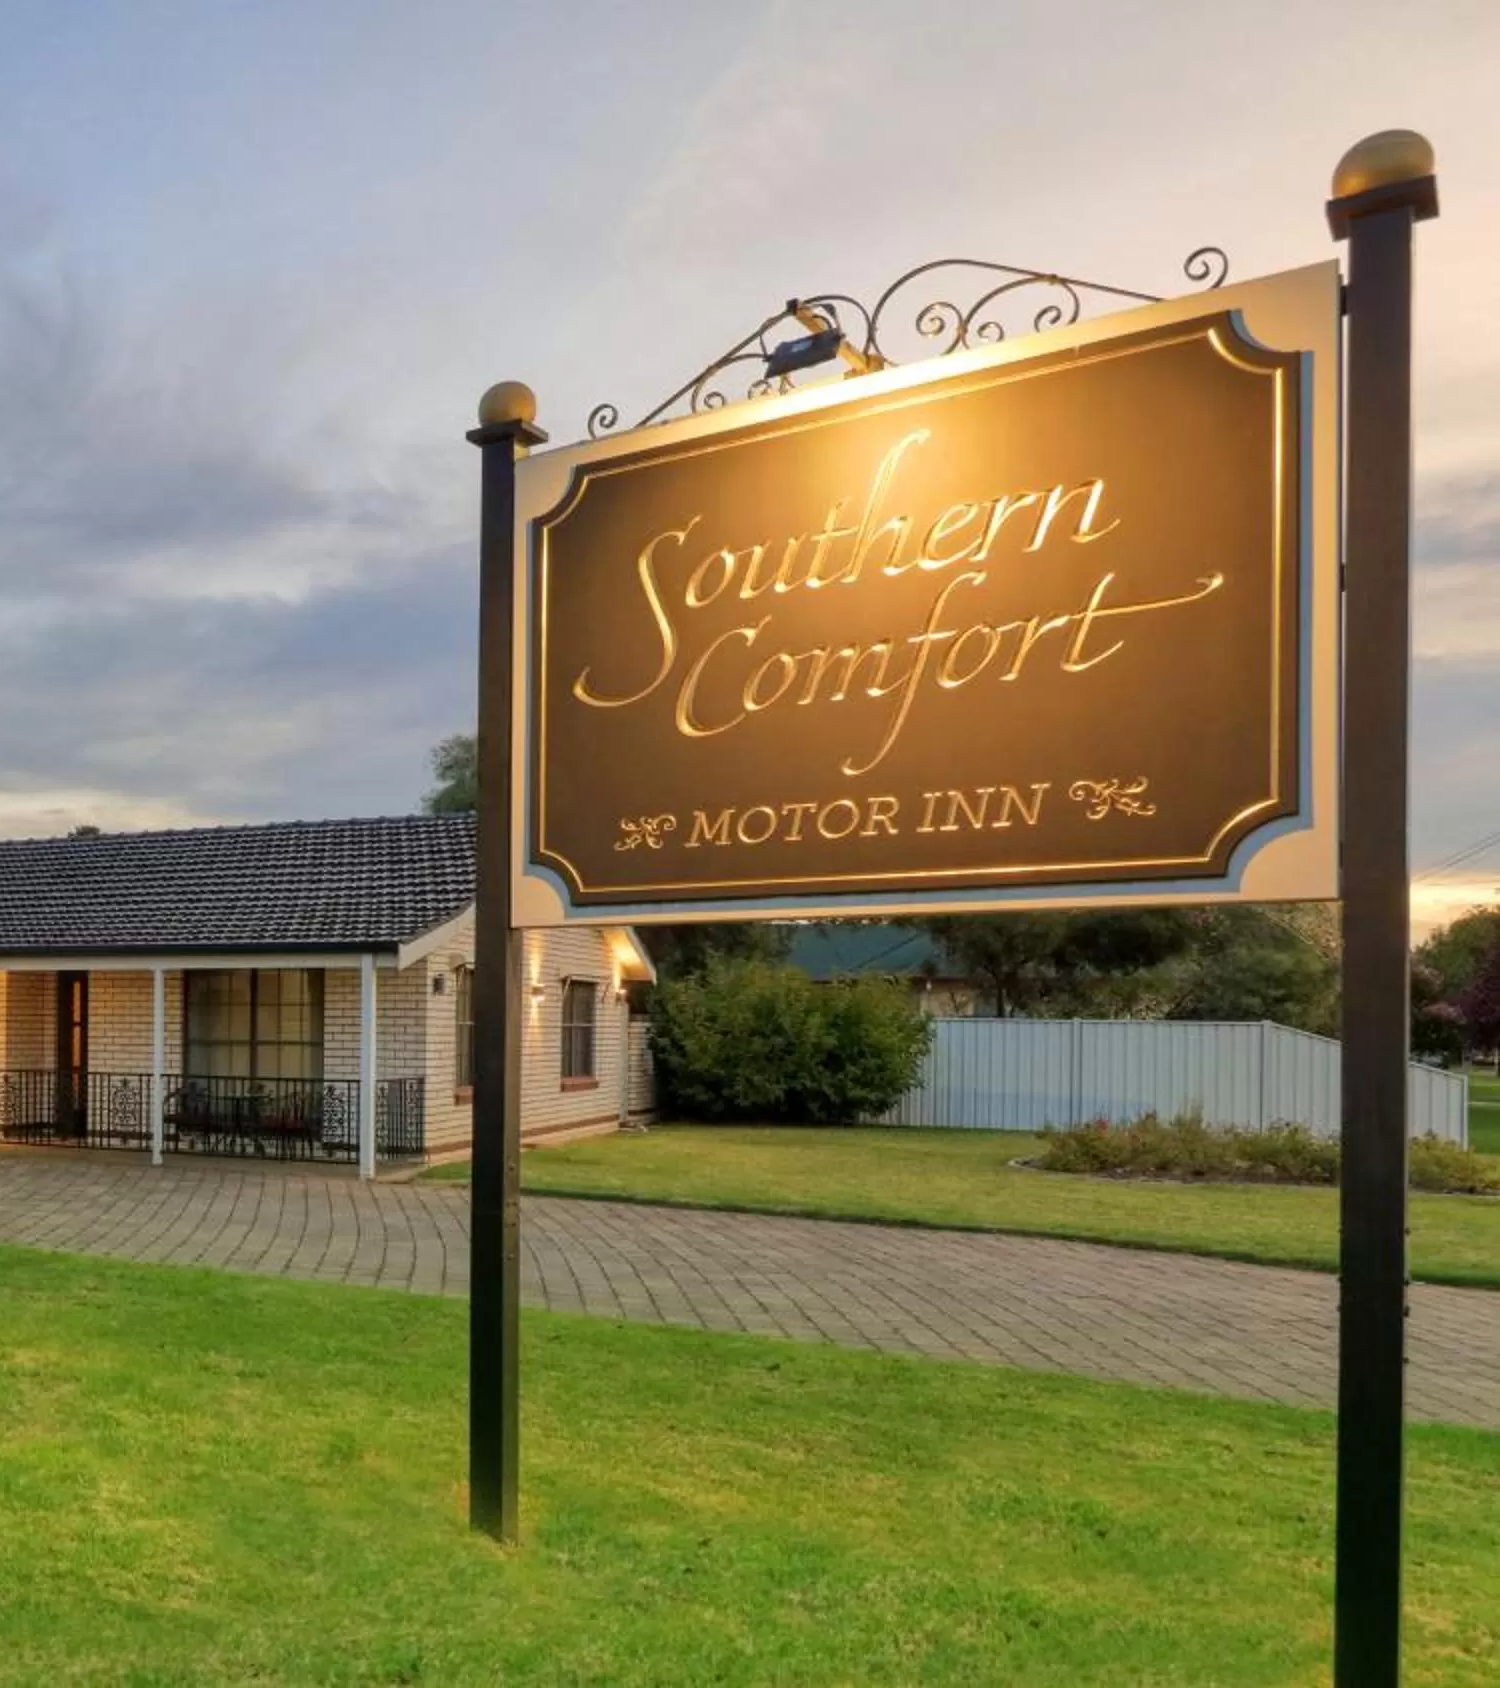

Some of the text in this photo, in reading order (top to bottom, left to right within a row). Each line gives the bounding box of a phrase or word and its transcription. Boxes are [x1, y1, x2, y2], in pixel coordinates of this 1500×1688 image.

[572, 427, 1121, 707] Southern
[674, 569, 1224, 776] Comfort
[684, 782, 1051, 848] MOTOR INN
